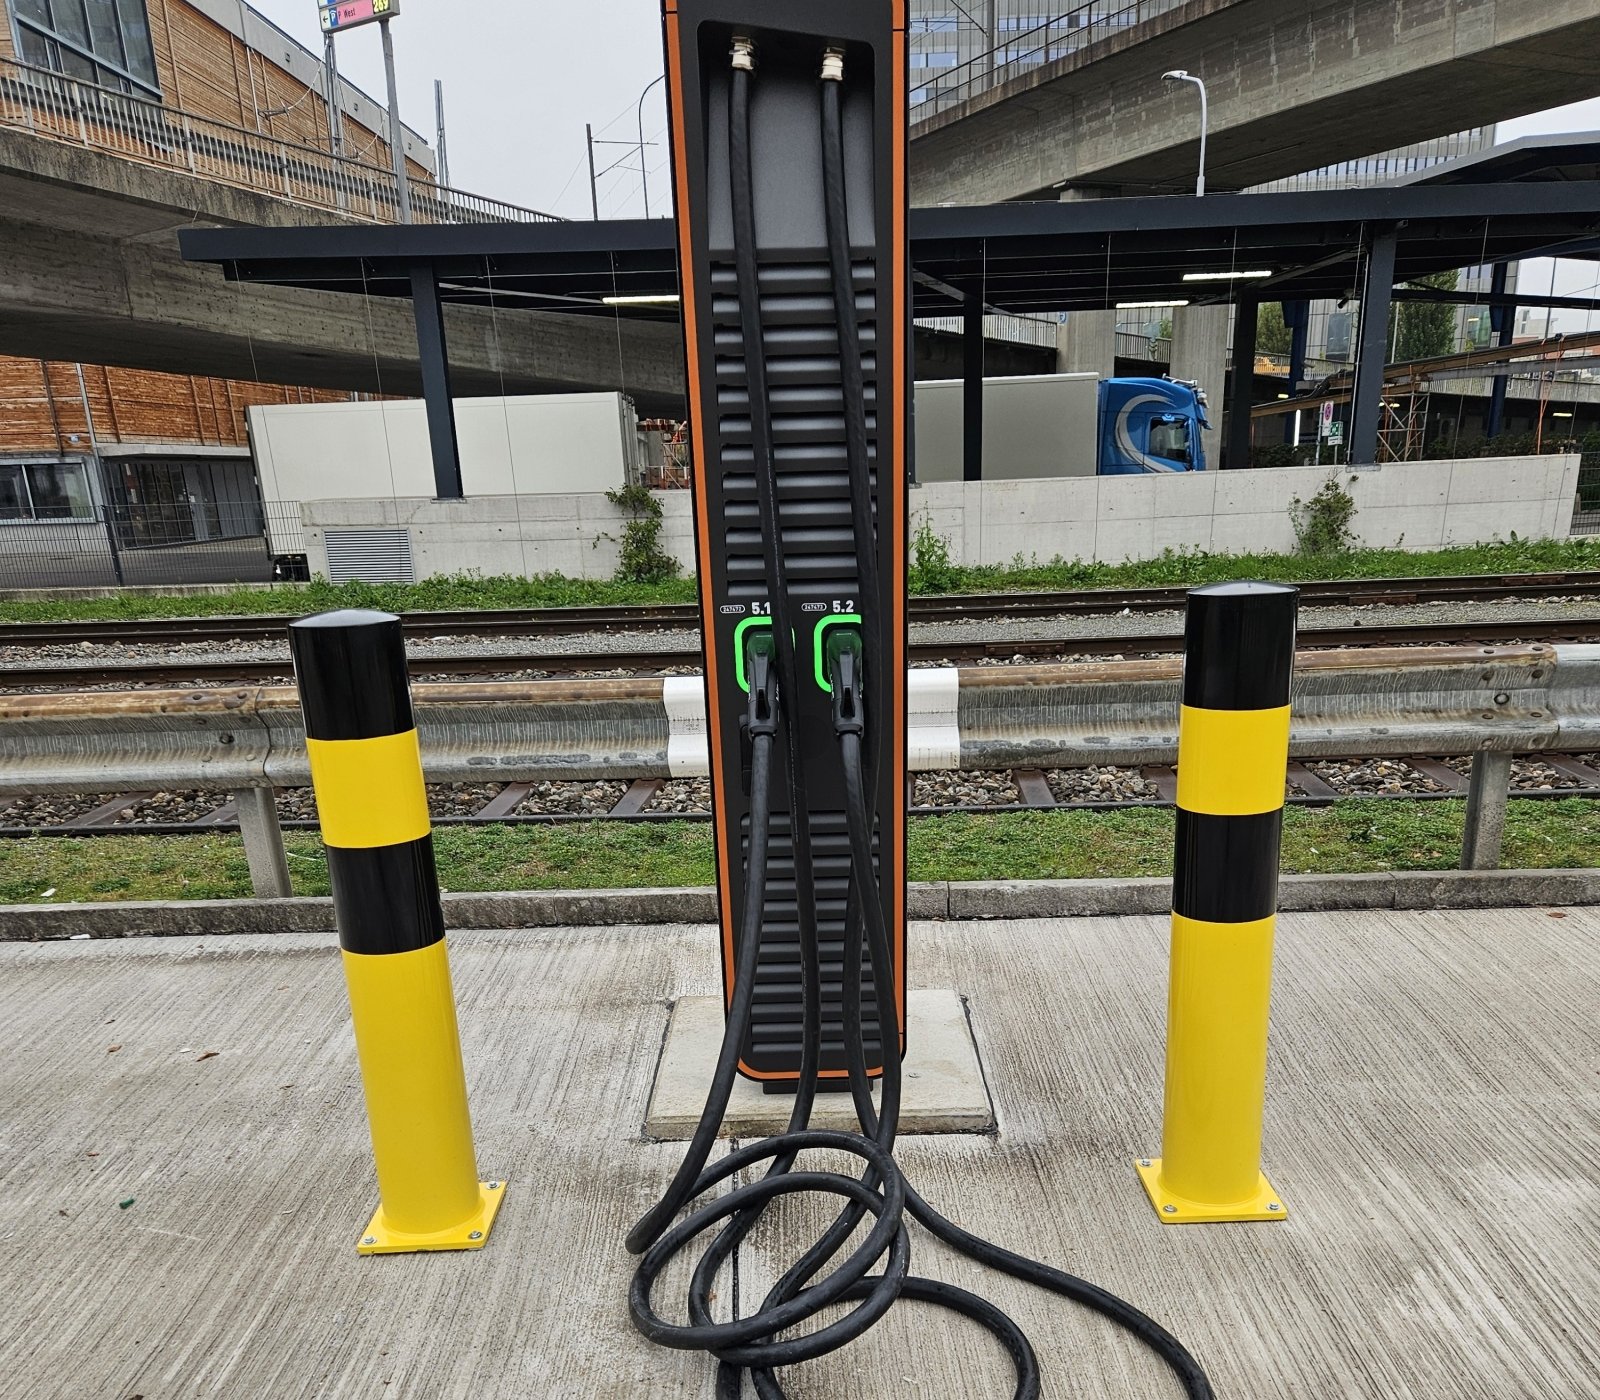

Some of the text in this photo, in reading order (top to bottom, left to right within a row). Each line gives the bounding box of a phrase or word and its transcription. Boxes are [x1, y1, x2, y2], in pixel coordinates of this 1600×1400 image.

[344, 8, 356, 18] West
[752, 602, 771, 615] 5.1
[833, 600, 854, 613] 5.2
